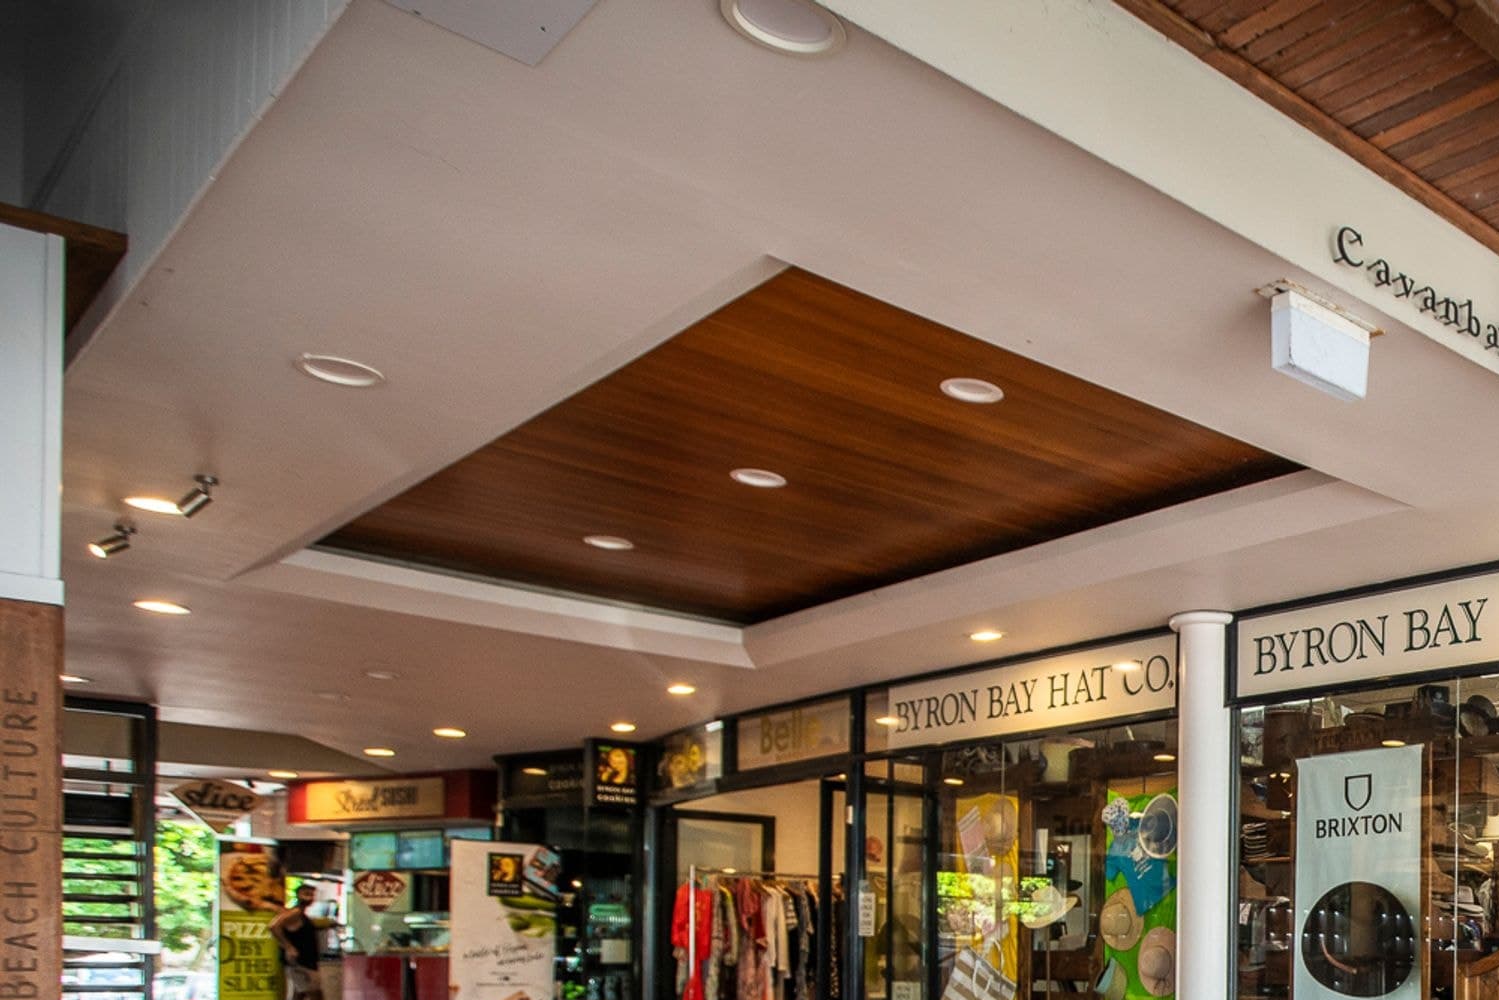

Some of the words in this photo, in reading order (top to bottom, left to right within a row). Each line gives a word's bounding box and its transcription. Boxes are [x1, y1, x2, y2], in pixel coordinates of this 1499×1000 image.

[1252, 617, 1388, 676] BYRON
[1403, 597, 1489, 652] BAY
[893, 691, 979, 735] BYRON
[986, 681, 1037, 719] BAY
[1047, 666, 1111, 710] HAT
[1122, 655, 1175, 697] CO.
[1, 690, 38, 855] CULTURE
[1315, 812, 1402, 839] BRIXTON
[1, 881, 38, 999] BEACH
[223, 922, 273, 939] PIZZ
